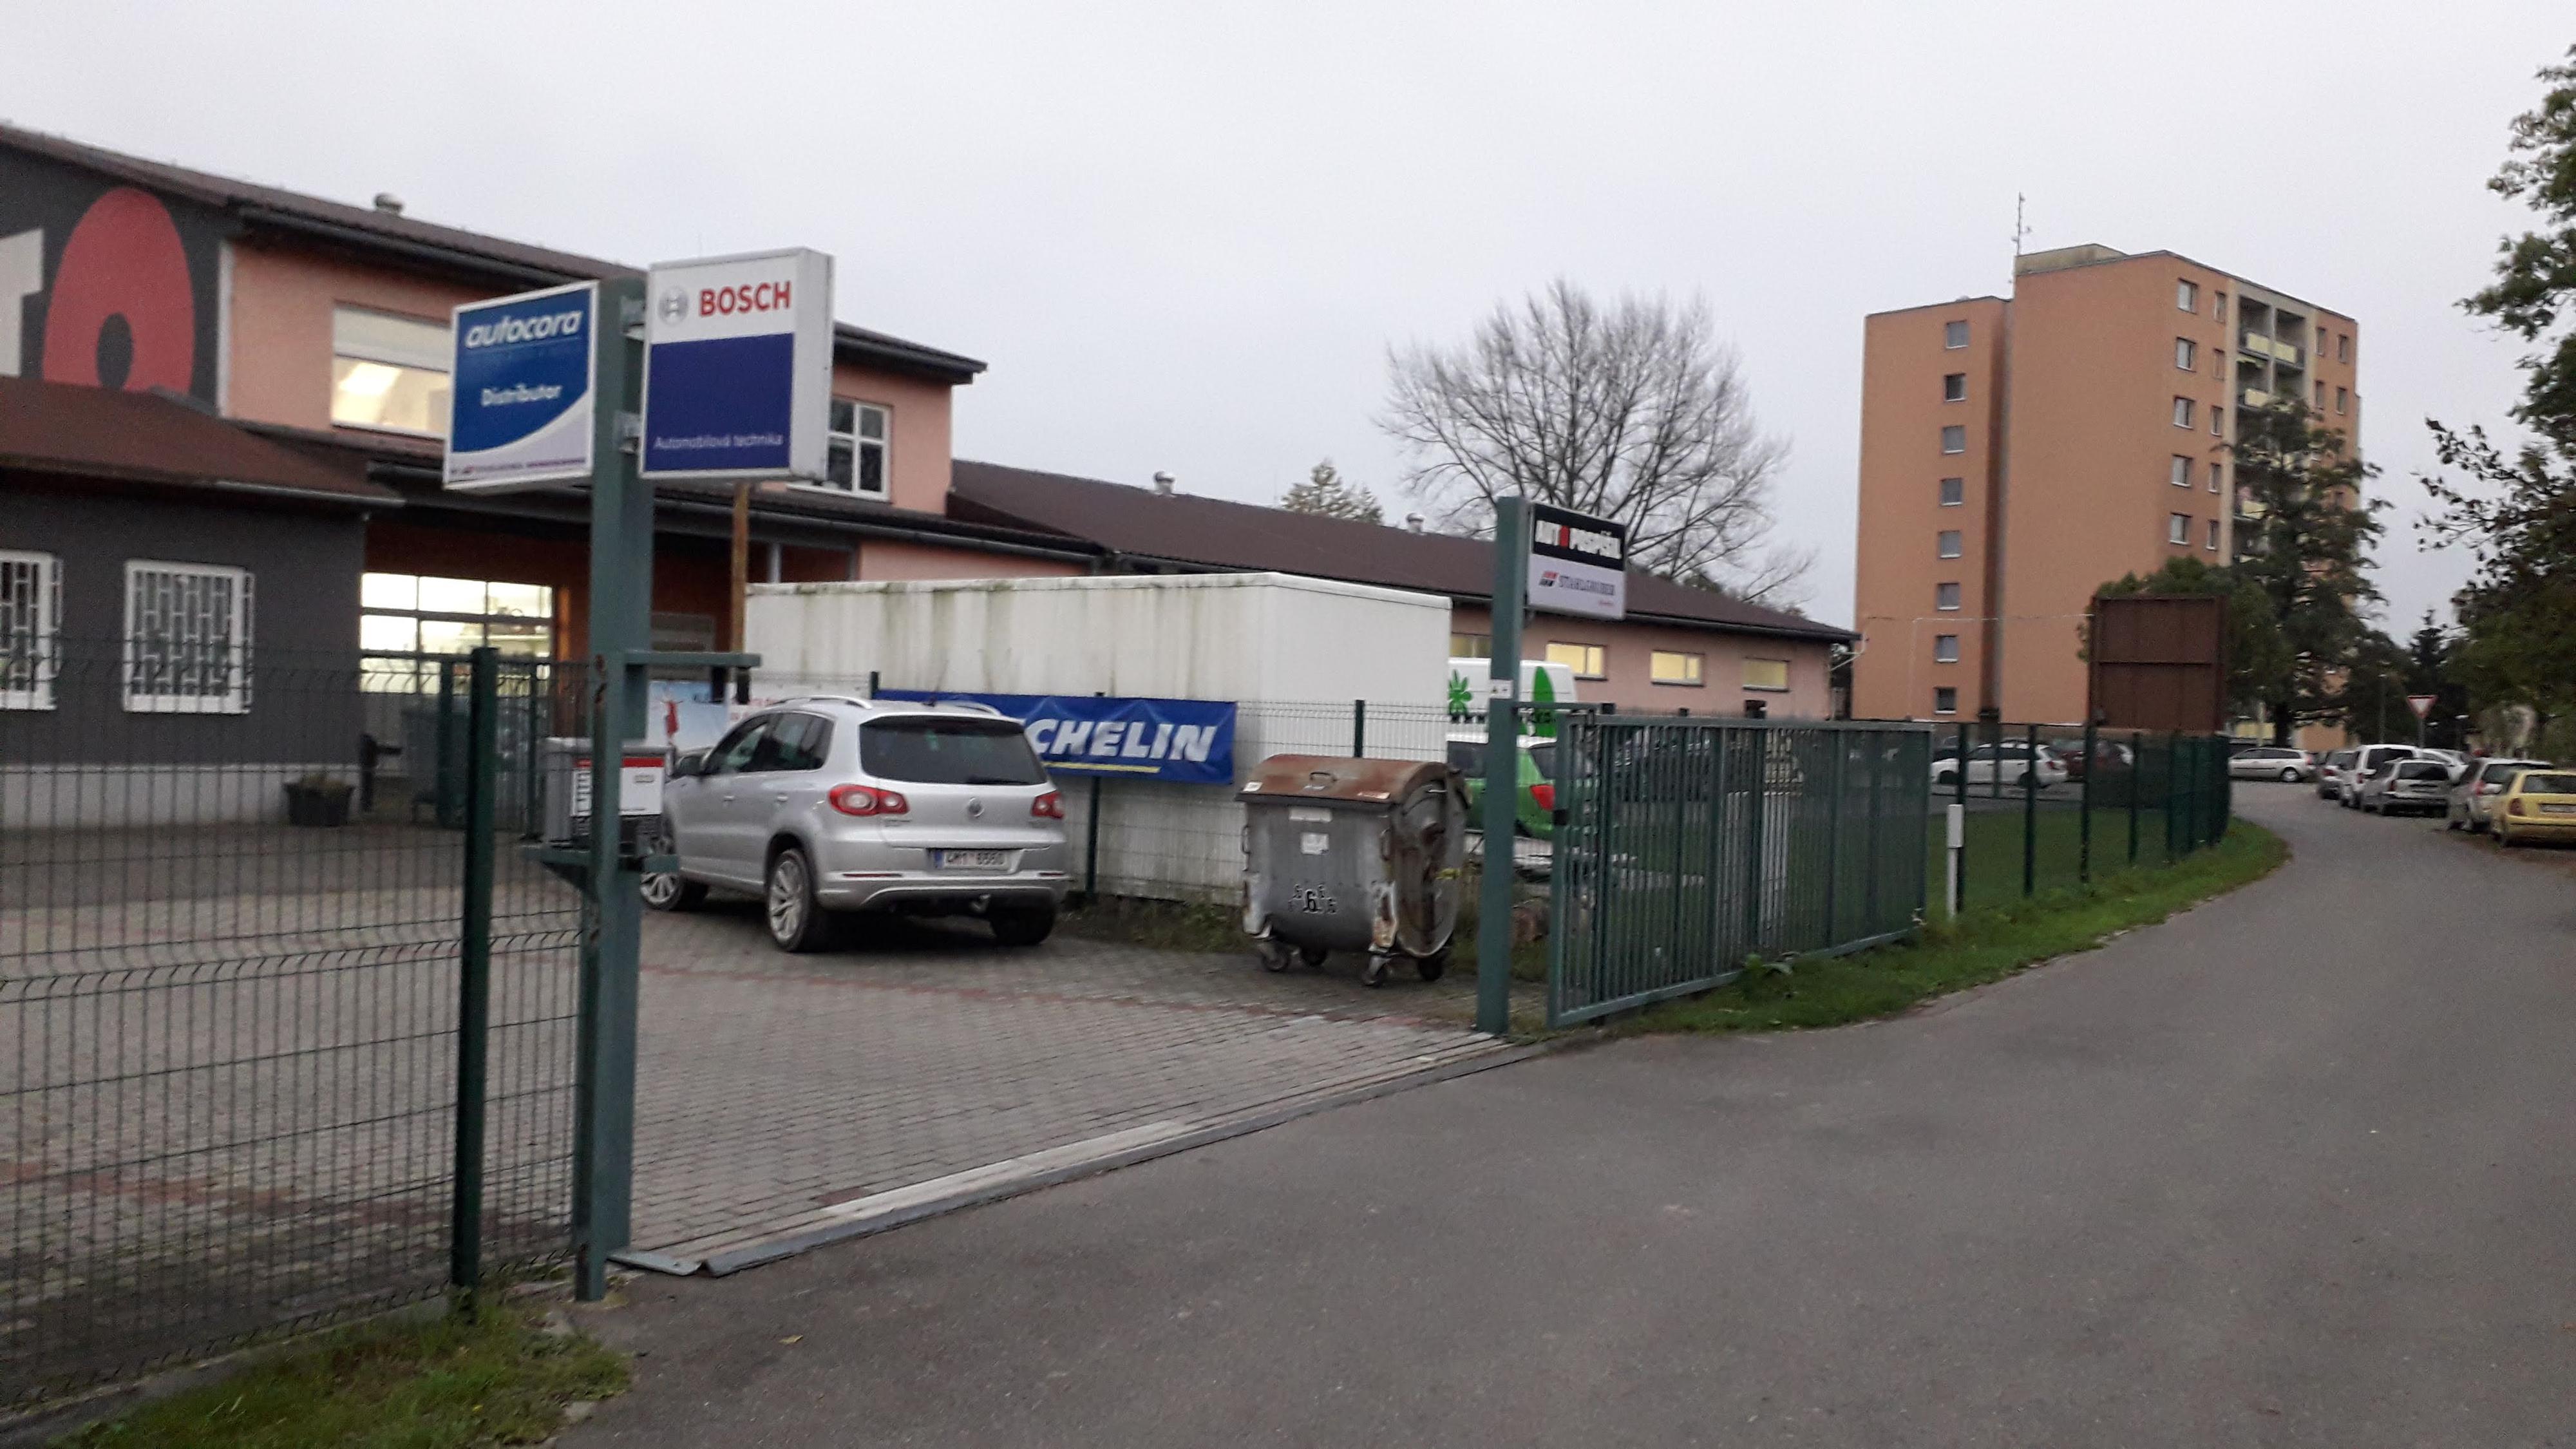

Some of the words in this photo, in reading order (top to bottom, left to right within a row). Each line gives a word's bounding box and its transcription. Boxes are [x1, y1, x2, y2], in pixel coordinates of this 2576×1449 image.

[699, 281, 791, 317] BOSCH
[466, 310, 582, 348] autocora
[482, 384, 561, 407] Distributor
[734, 433, 784, 446] technika
[1030, 718, 1218, 762] CHELIN
